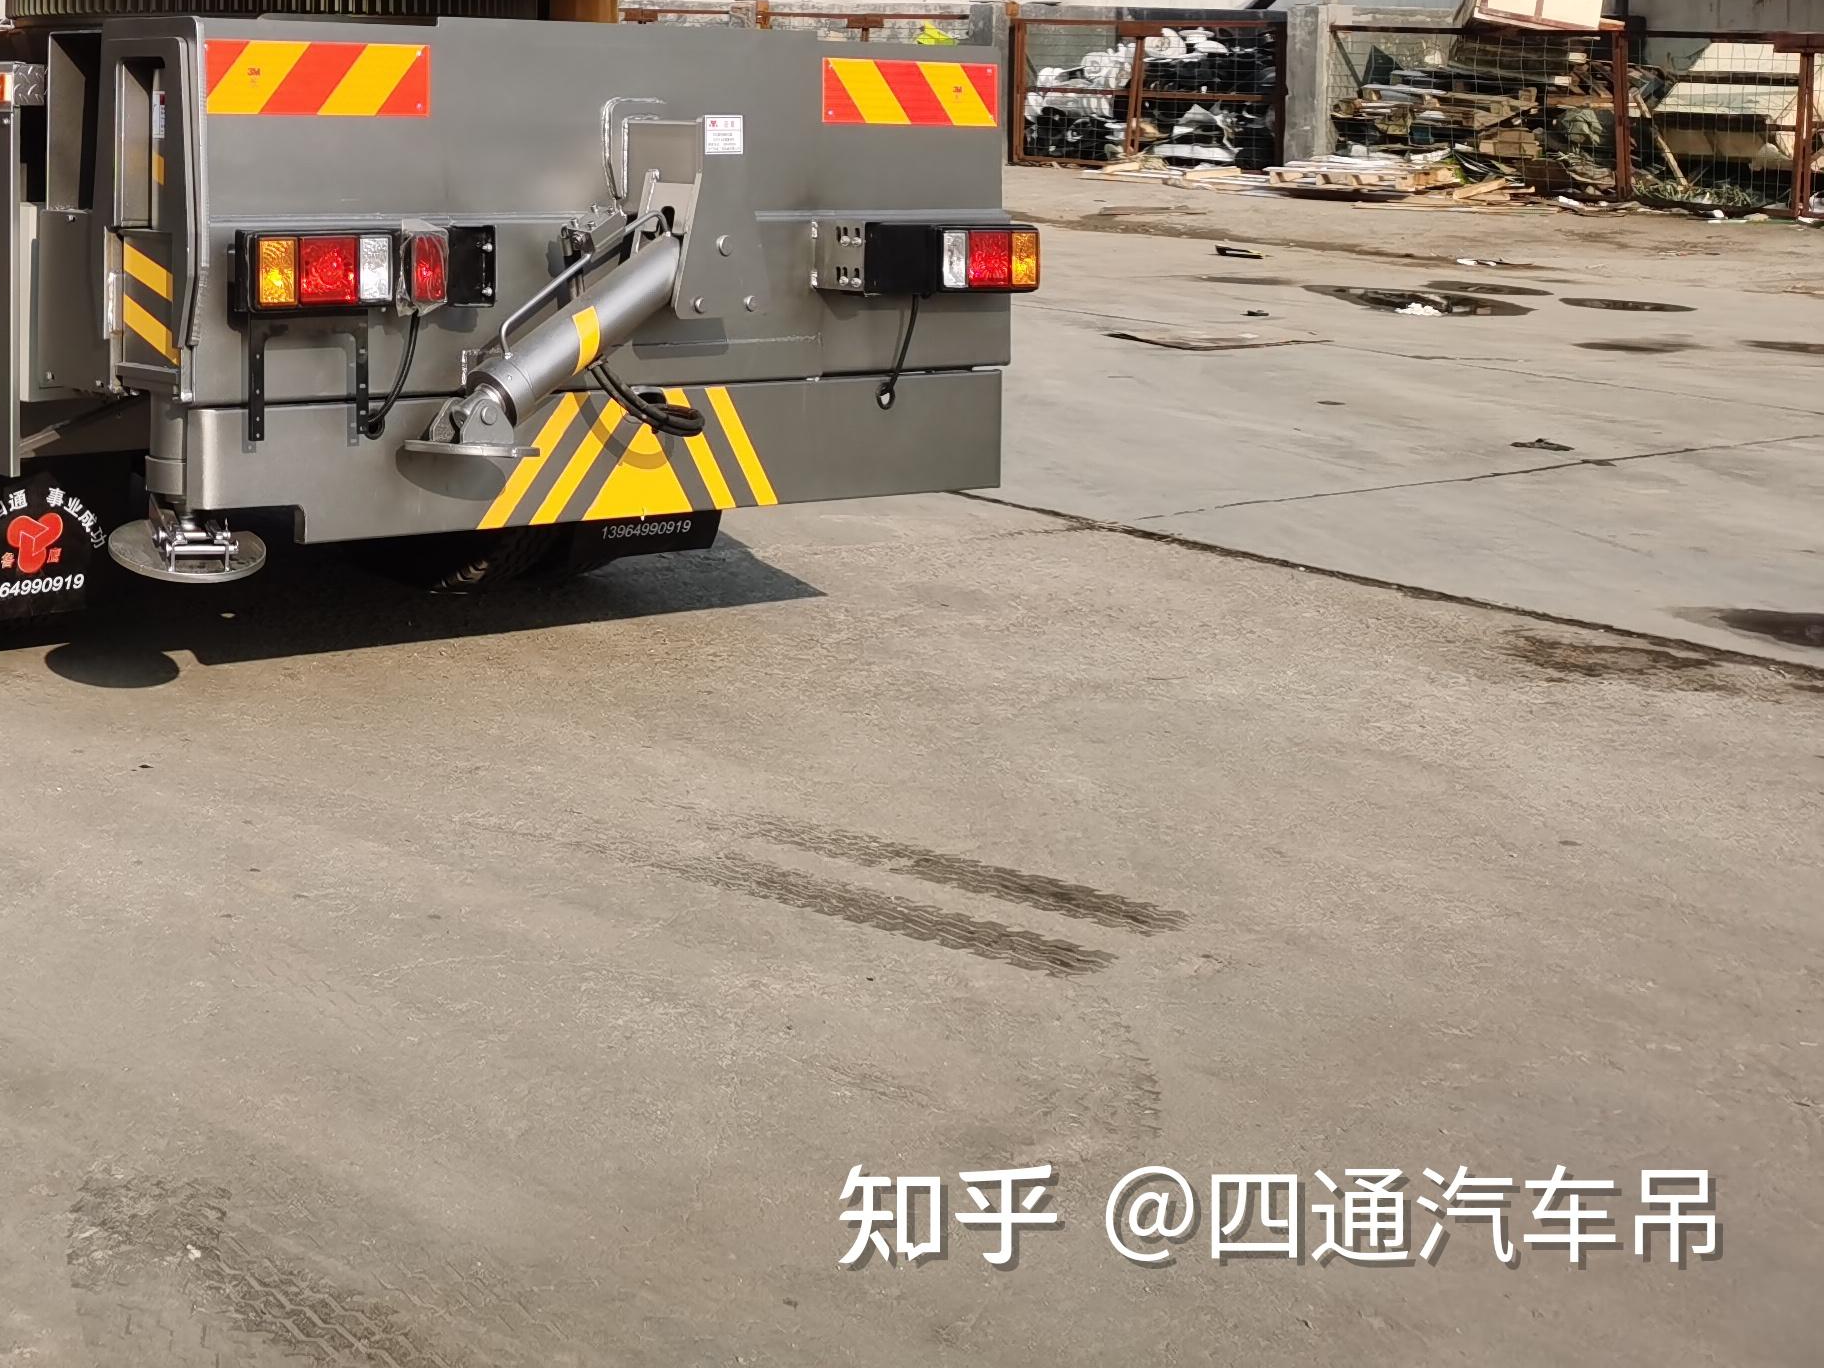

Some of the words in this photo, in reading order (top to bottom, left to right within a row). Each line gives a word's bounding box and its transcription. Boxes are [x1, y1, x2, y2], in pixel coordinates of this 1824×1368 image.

[45, 487, 107, 549] 事业成功
[601, 519, 692, 540] 13964990919
